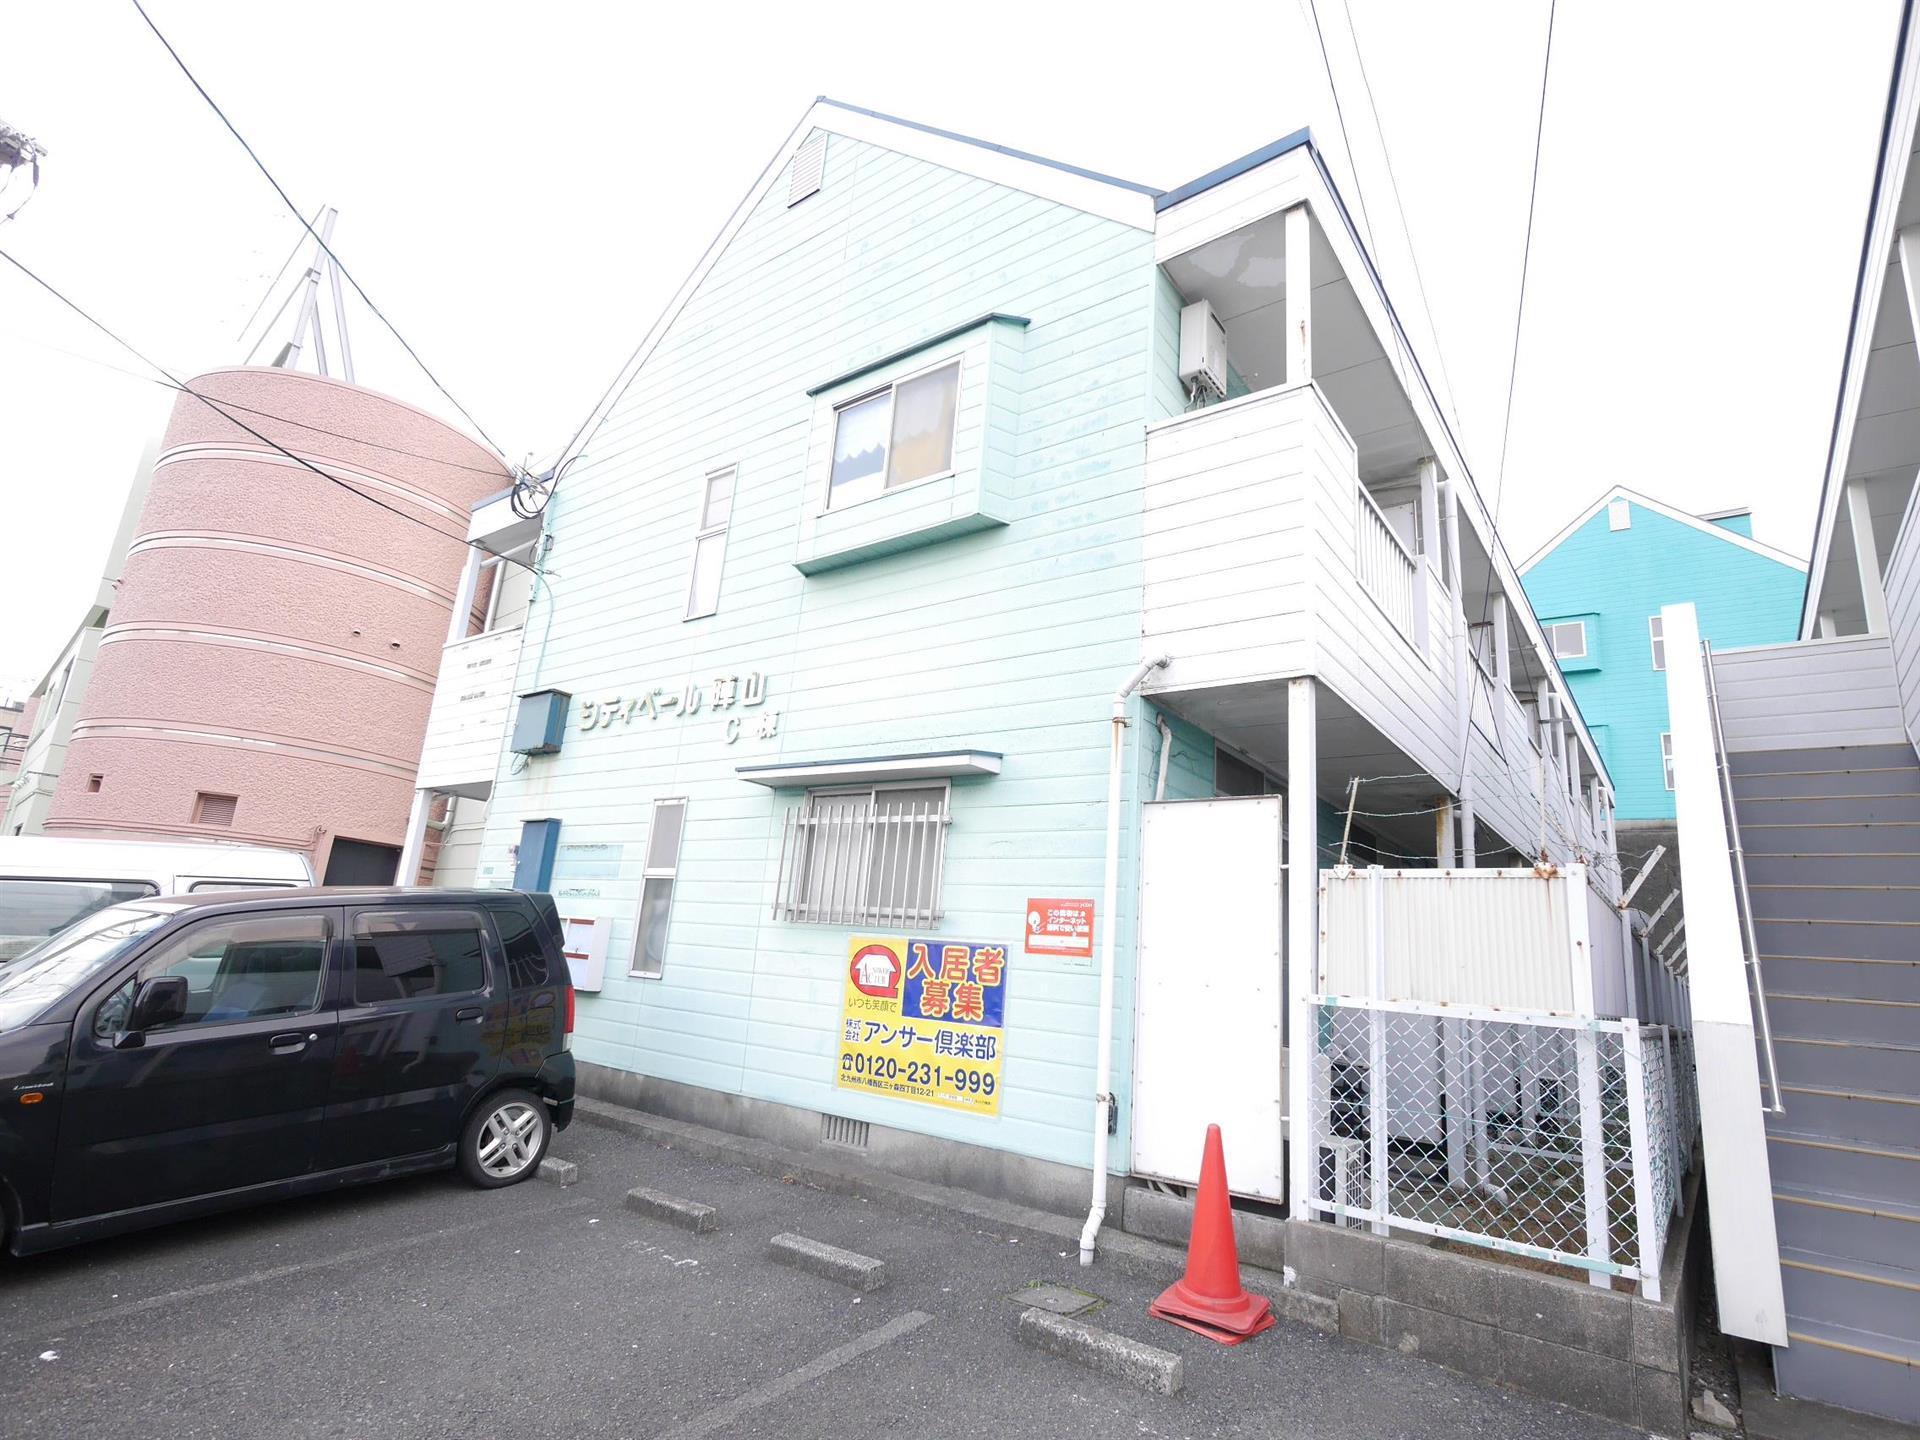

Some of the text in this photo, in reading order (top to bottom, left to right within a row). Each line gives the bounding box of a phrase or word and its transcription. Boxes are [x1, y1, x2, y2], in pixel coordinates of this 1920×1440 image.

[908, 943, 1004, 987] 入居者
[848, 998, 898, 1013] いつも笑顔で
[919, 979, 985, 1021] 募集
[844, 1030, 860, 1042] 会社
[845, 1018, 861, 1031] 株式
[864, 1021, 997, 1061] アンサー倶楽部
[855, 1052, 996, 1097] 0120-231-999
